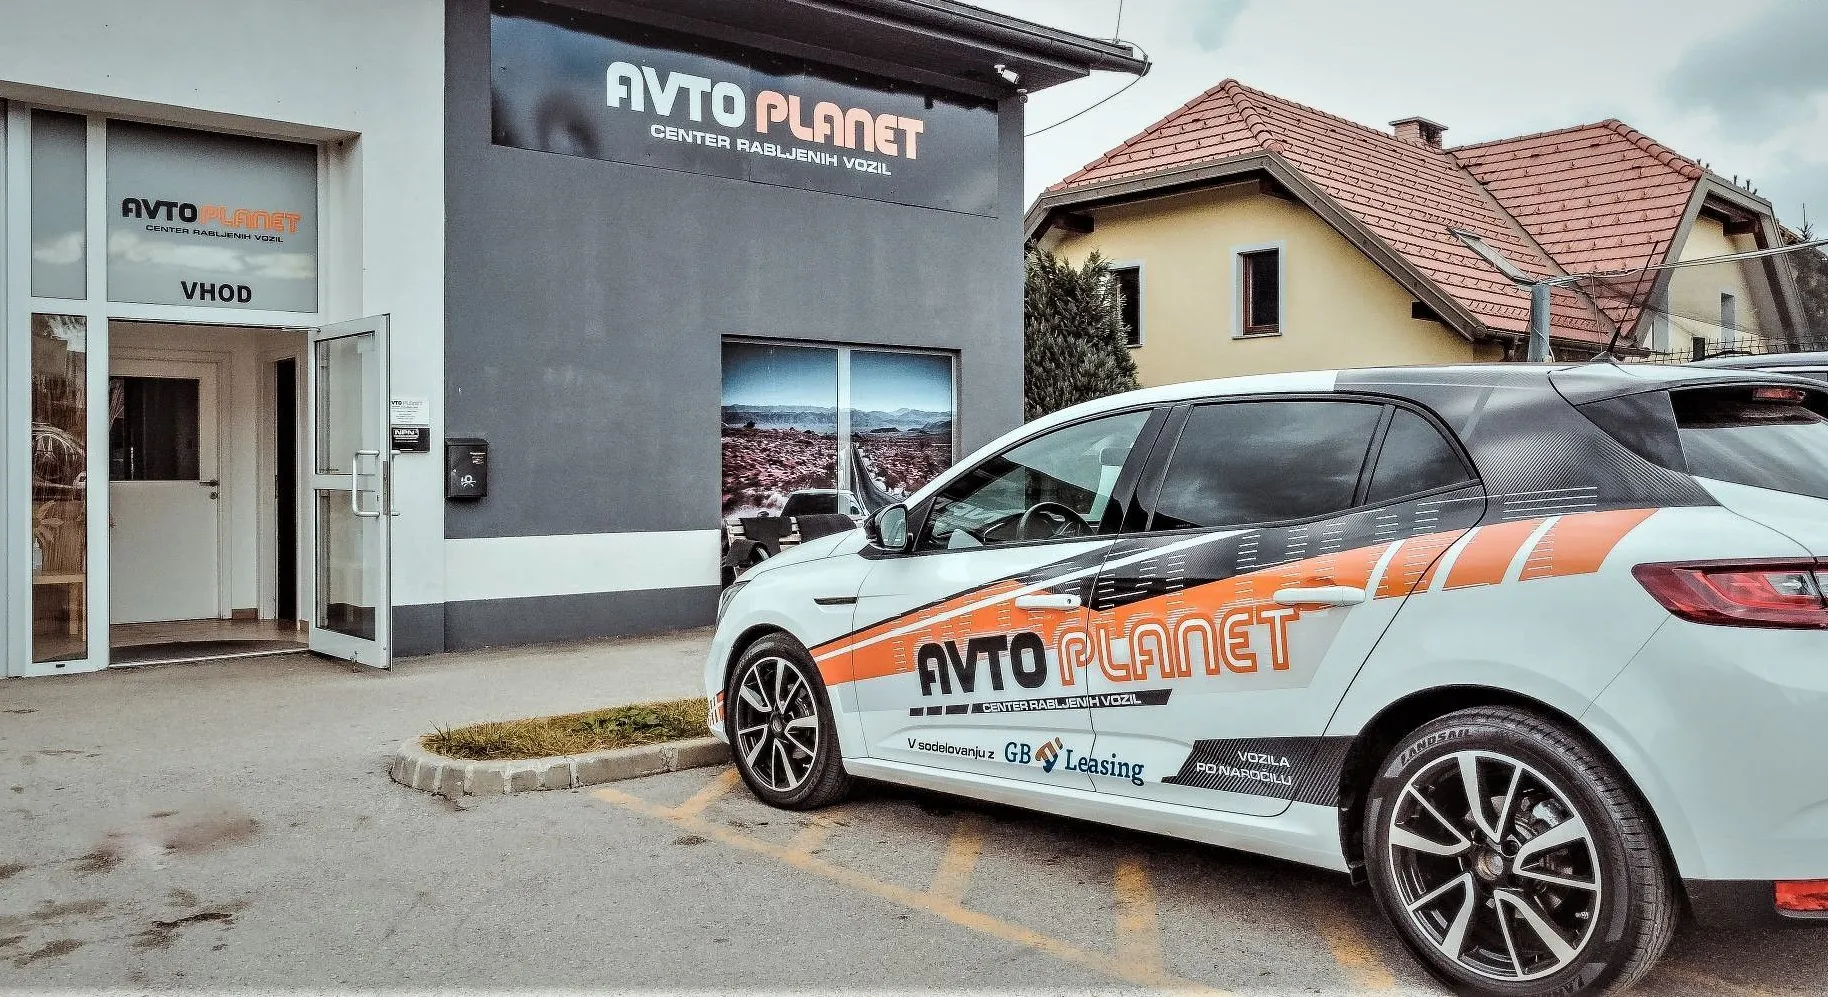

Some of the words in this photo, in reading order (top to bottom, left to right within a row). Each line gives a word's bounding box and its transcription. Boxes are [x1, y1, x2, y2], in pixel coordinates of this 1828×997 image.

[606, 61, 747, 128] AVTO
[755, 90, 924, 160] PLANET
[650, 124, 731, 150] CENTER
[736, 138, 838, 167] RABLJENIH
[843, 156, 892, 176] VOZIL
[121, 198, 198, 223] AVTO
[199, 204, 303, 234] PLANET
[145, 224, 189, 234] CENTER
[193, 229, 251, 240] RABLJENIH
[254, 234, 284, 243] VOZIL
[180, 280, 252, 303] VHOD
[917, 632, 1048, 697] AVTO
[1056, 606, 1301, 688] PLANET
[982, 702, 1029, 714] CENTER
[1029, 696, 1100, 712] RABLJENIH
[1101, 693, 1142, 706] VOZIL
[907, 737, 917, 749] V
[918, 740, 986, 759] sodelovanju
[987, 750, 995, 760] z
[1004, 741, 1032, 765] GB
[1064, 749, 1145, 787] Leasing
[1196, 762, 1217, 774] PO
[1218, 764, 1292, 786] NAROČILU
[1237, 750, 1291, 768] VOZILA
